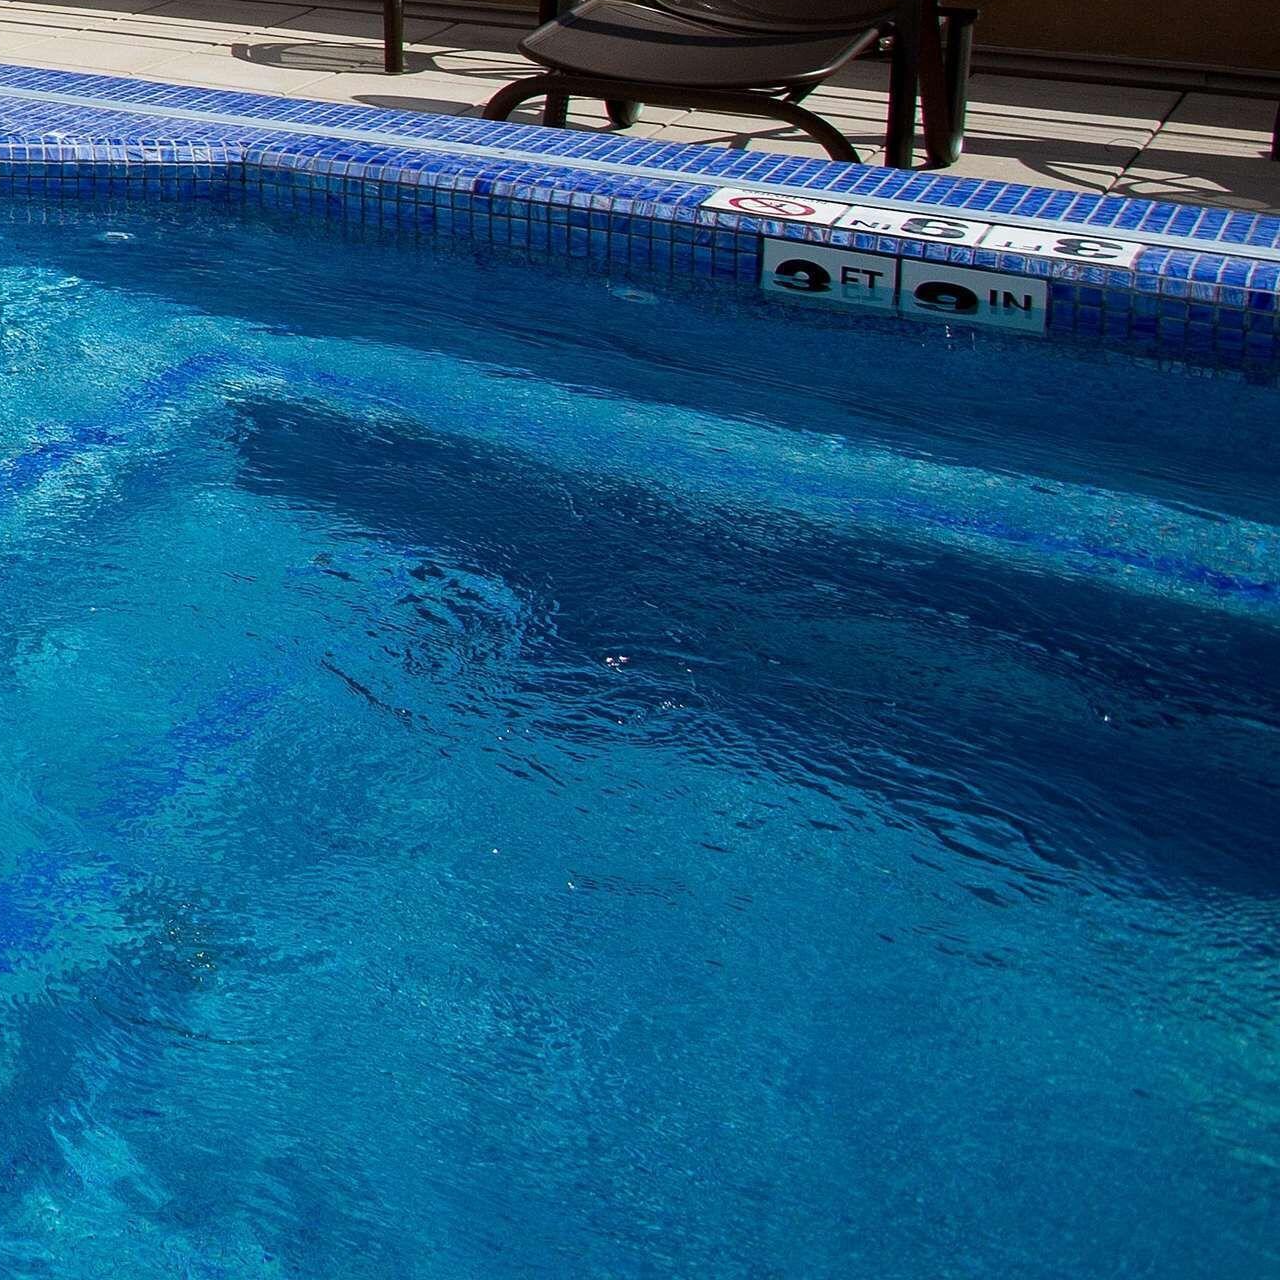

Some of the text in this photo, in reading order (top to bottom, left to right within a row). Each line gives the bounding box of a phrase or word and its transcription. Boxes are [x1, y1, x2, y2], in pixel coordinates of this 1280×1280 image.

[850, 217, 1124, 259] 3 FT 9 IN
[773, 259, 1032, 315] 3 FT 9 IN
